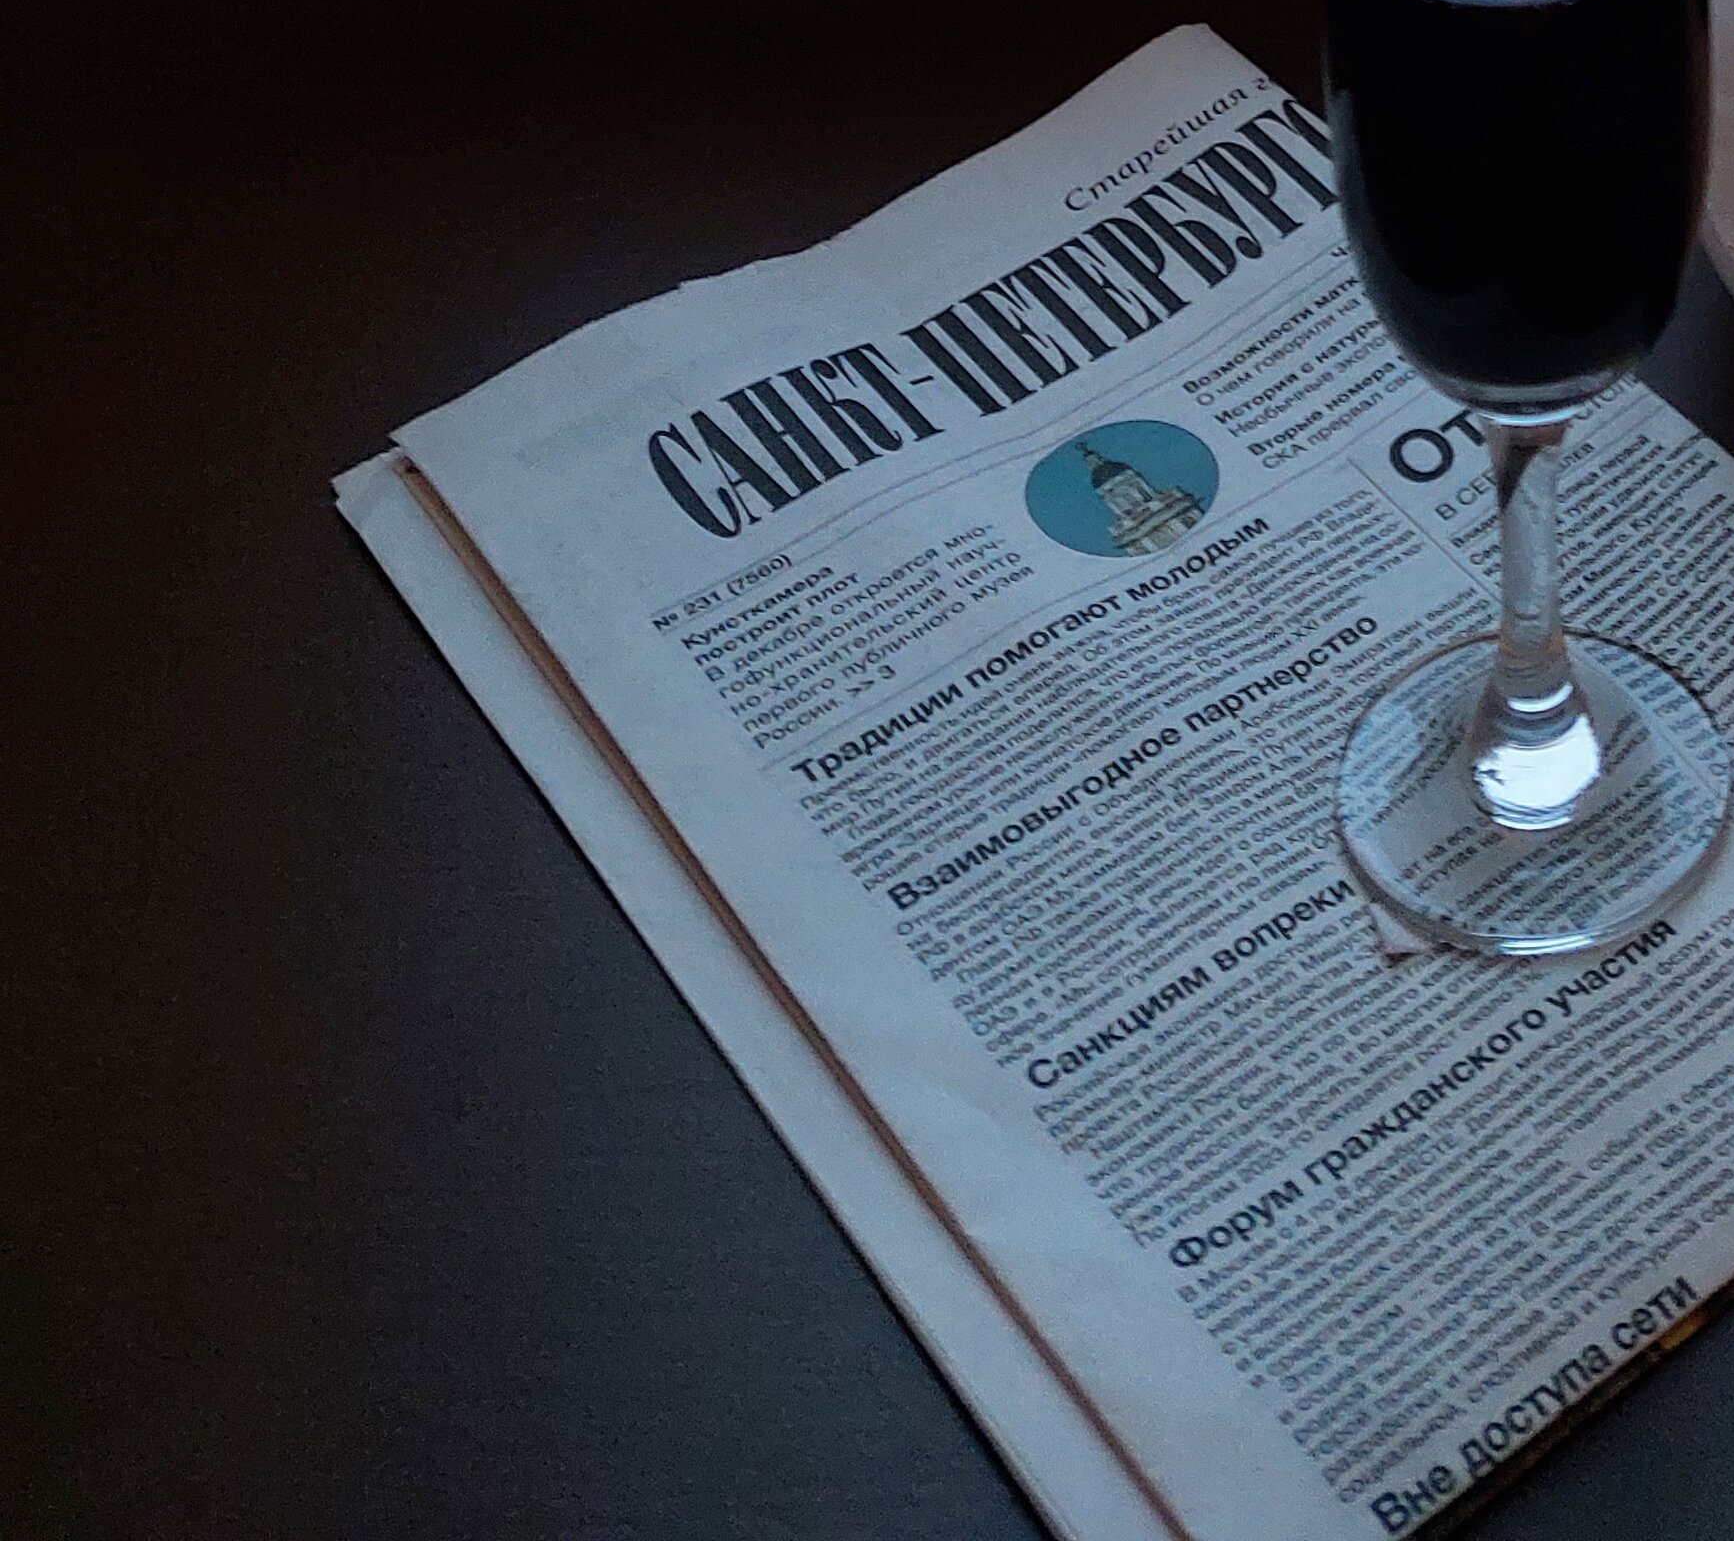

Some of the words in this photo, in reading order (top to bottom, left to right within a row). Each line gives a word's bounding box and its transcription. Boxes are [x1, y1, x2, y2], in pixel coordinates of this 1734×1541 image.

[1064, 83, 1248, 213] Старейшая
[1182, 307, 1313, 393] Возможности
[1194, 391, 1215, 406] О
[1216, 371, 1252, 393] чем
[1252, 314, 1336, 373] говорили
[1336, 298, 1361, 315] на
[1218, 373, 1298, 424] История
[1300, 362, 1314, 373] с
[1230, 371, 1333, 437] Необычные
[1334, 334, 1385, 373] экспо
[1251, 410, 1323, 456] Вторые
[1324, 361, 1396, 410] номера
[1262, 443, 1305, 469] СКА
[1306, 391, 1383, 445] прервал
[1383, 369, 1415, 393] сво
[1434, 502, 1457, 520] В
[683, 590, 721, 615] 231
[683, 566, 833, 649] Кунсткамера
[694, 604, 800, 666] построит
[804, 572, 858, 607] плот
[704, 665, 725, 682] В
[732, 614, 824, 671] декабре
[829, 547, 939, 615] откроется
[942, 524, 993, 549] мно-
[718, 568, 940, 698] гофункциональный
[946, 539, 1004, 570] науч-
[729, 588, 947, 715] но-хранительский
[953, 551, 1021, 588] центр
[742, 677, 835, 732] первого
[839, 600, 965, 678] публичного
[970, 566, 1034, 601] музея
[790, 683, 963, 782] Традиции
[964, 594, 1121, 688] помогают
[1125, 517, 1269, 601] молодым
[1111, 623, 1153, 647] этом
[887, 727, 1181, 910] Взаимовыгодное
[1183, 616, 1377, 732] партнерство
[1026, 965, 1211, 1088] Санкциям
[1211, 879, 1355, 971] вопреки
[1168, 1179, 1303, 1267] Форум
[1303, 1008, 1563, 1185] гражданского
[1544, 919, 1676, 1017] участия
[1369, 1464, 1456, 1534] Вне
[1459, 1343, 1611, 1479] доступа
[1610, 1276, 1697, 1350] сети
